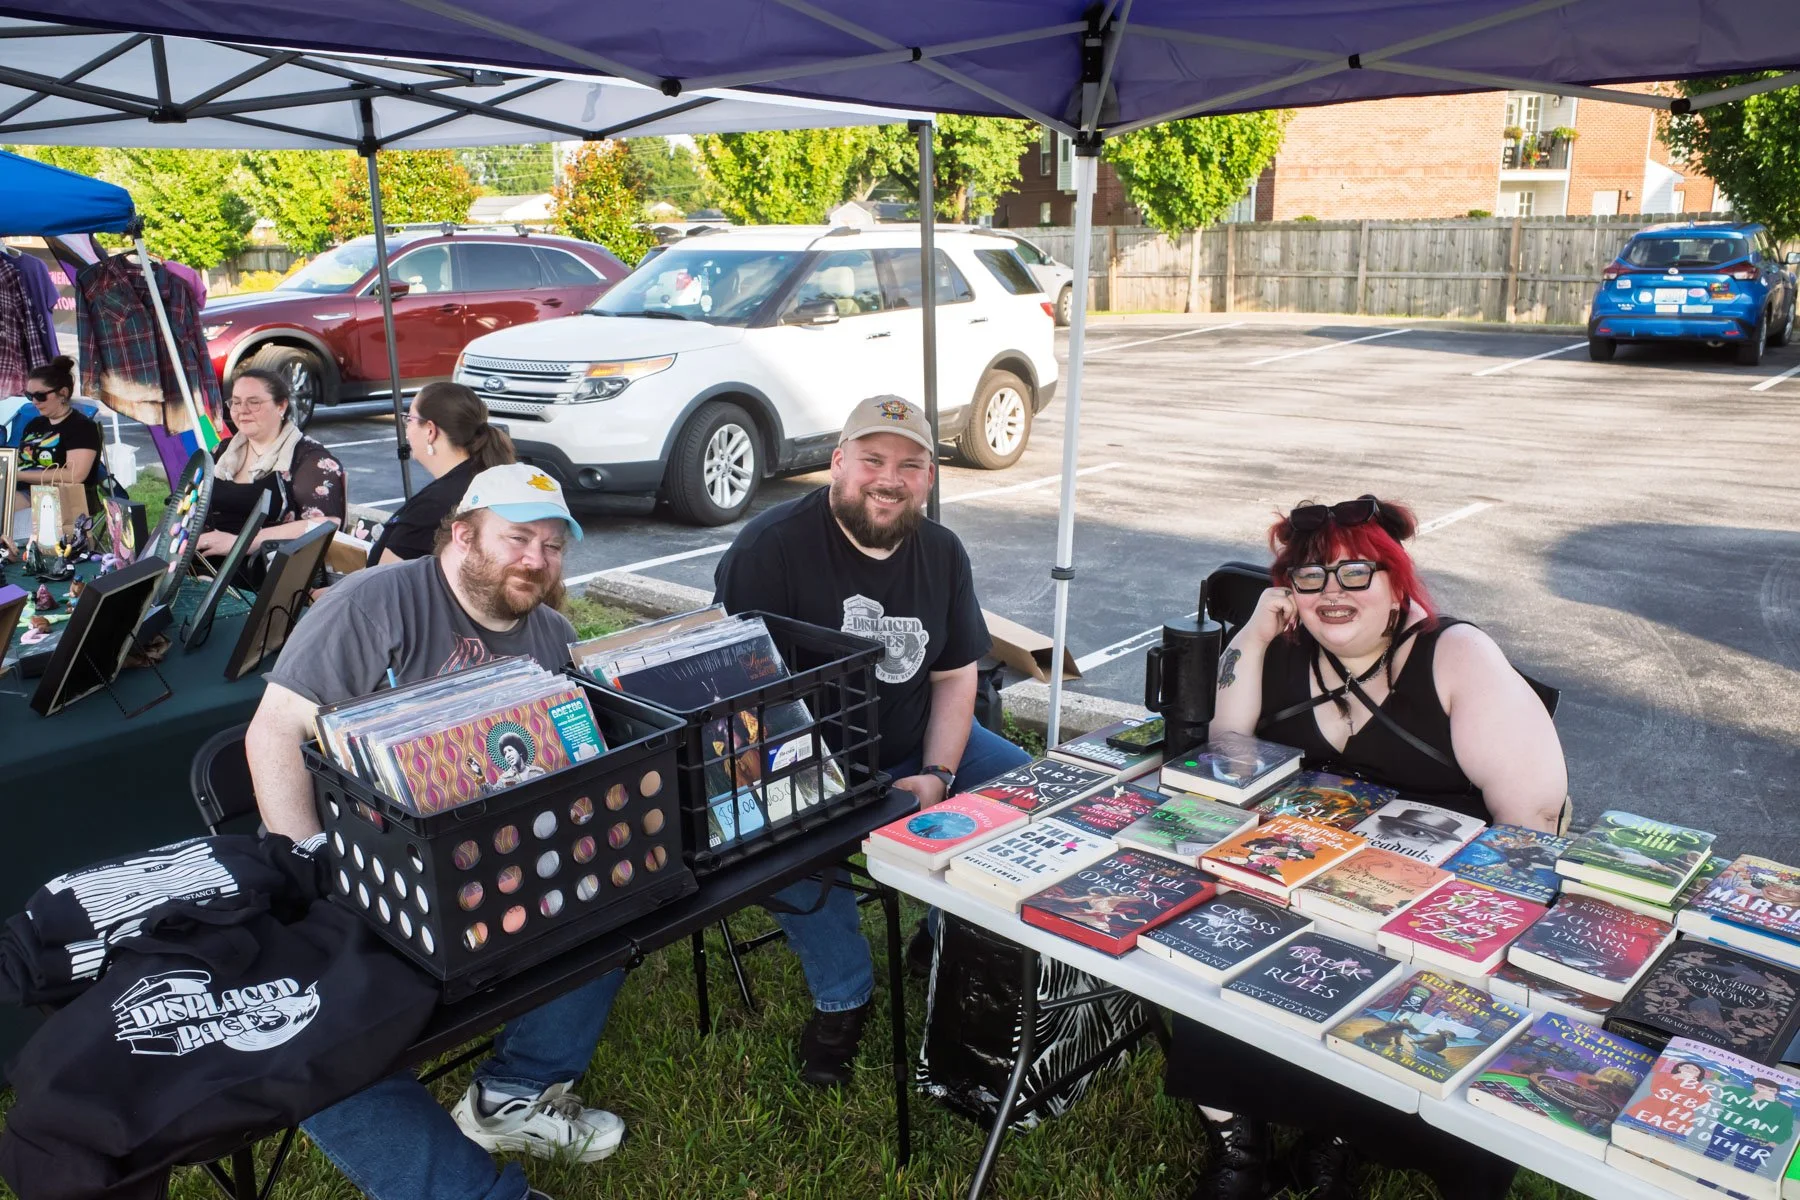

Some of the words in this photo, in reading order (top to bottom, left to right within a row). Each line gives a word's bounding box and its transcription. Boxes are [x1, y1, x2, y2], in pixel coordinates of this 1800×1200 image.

[852, 617, 921, 632] DISPLACED
[1061, 744, 1127, 765] KUSHNER
[1032, 766, 1089, 784] FIRST
[1060, 764, 1086, 774] THE
[992, 782, 1054, 803] THING
[1004, 772, 1079, 796] BRIGHT
[1162, 804, 1240, 825] WRITING
[1037, 823, 1087, 843] THEY
[1254, 823, 1349, 851] ALEJANDRA
[1287, 820, 1345, 841] HAUNTING
[987, 844, 1013, 858] US
[1013, 855, 1048, 874] ALL
[1003, 837, 1044, 858] KILL
[150, 864, 166, 873] ART
[964, 856, 992, 869] WESLEY
[991, 867, 1023, 882] LOWERY
[1102, 859, 1185, 895] BREATH
[1078, 870, 1165, 909] DRAGON
[1133, 879, 1151, 889] THE
[1376, 882, 1395, 895] Shy
[1517, 879, 1555, 894] WERE
[1526, 888, 1551, 899] GOD
[1210, 903, 1281, 936] CROSS
[1217, 918, 1248, 936] MY
[1567, 915, 1637, 943] CHARM
[1580, 904, 1648, 929] KINGSLEY
[1178, 917, 1254, 951] HEART
[1551, 929, 1628, 961] PRINCE
[1146, 930, 1181, 948] ROXY
[1181, 945, 1231, 970] SLOANE
[1212, 954, 1233, 966] AUTHOR
[1289, 948, 1363, 982] BREAK
[1293, 963, 1337, 982] MY
[1263, 966, 1340, 1000] RULES
[1686, 977, 1757, 1008] SORROWS
[1695, 967, 1766, 998] SONGBIRD
[129, 977, 300, 1028] DISPLACED
[1229, 983, 1268, 999] ROXY
[1268, 996, 1326, 1021] SLOANE
[1417, 972, 1487, 1003] Murder
[1491, 1001, 1521, 1019] On
[1446, 992, 1491, 1017] Tour
[1303, 1004, 1329, 1017] AUTHOR
[177, 1005, 284, 1051] PAGES
[1547, 1017, 1590, 1039] Next
[1576, 1022, 1599, 1035] The
[1561, 1032, 1636, 1066] Chapter
[1684, 1042, 1743, 1065] BETHANY
[1400, 1056, 1446, 1080] BURNS
[1616, 1063, 1645, 1079] BURN
[1679, 1077, 1769, 1112] BRYNN
[1654, 1087, 1780, 1134] SEBASTIAN
[1667, 1106, 1738, 1137] HATE
[1635, 1110, 1695, 1136] EACH
[1697, 1131, 1772, 1167] OTHER
